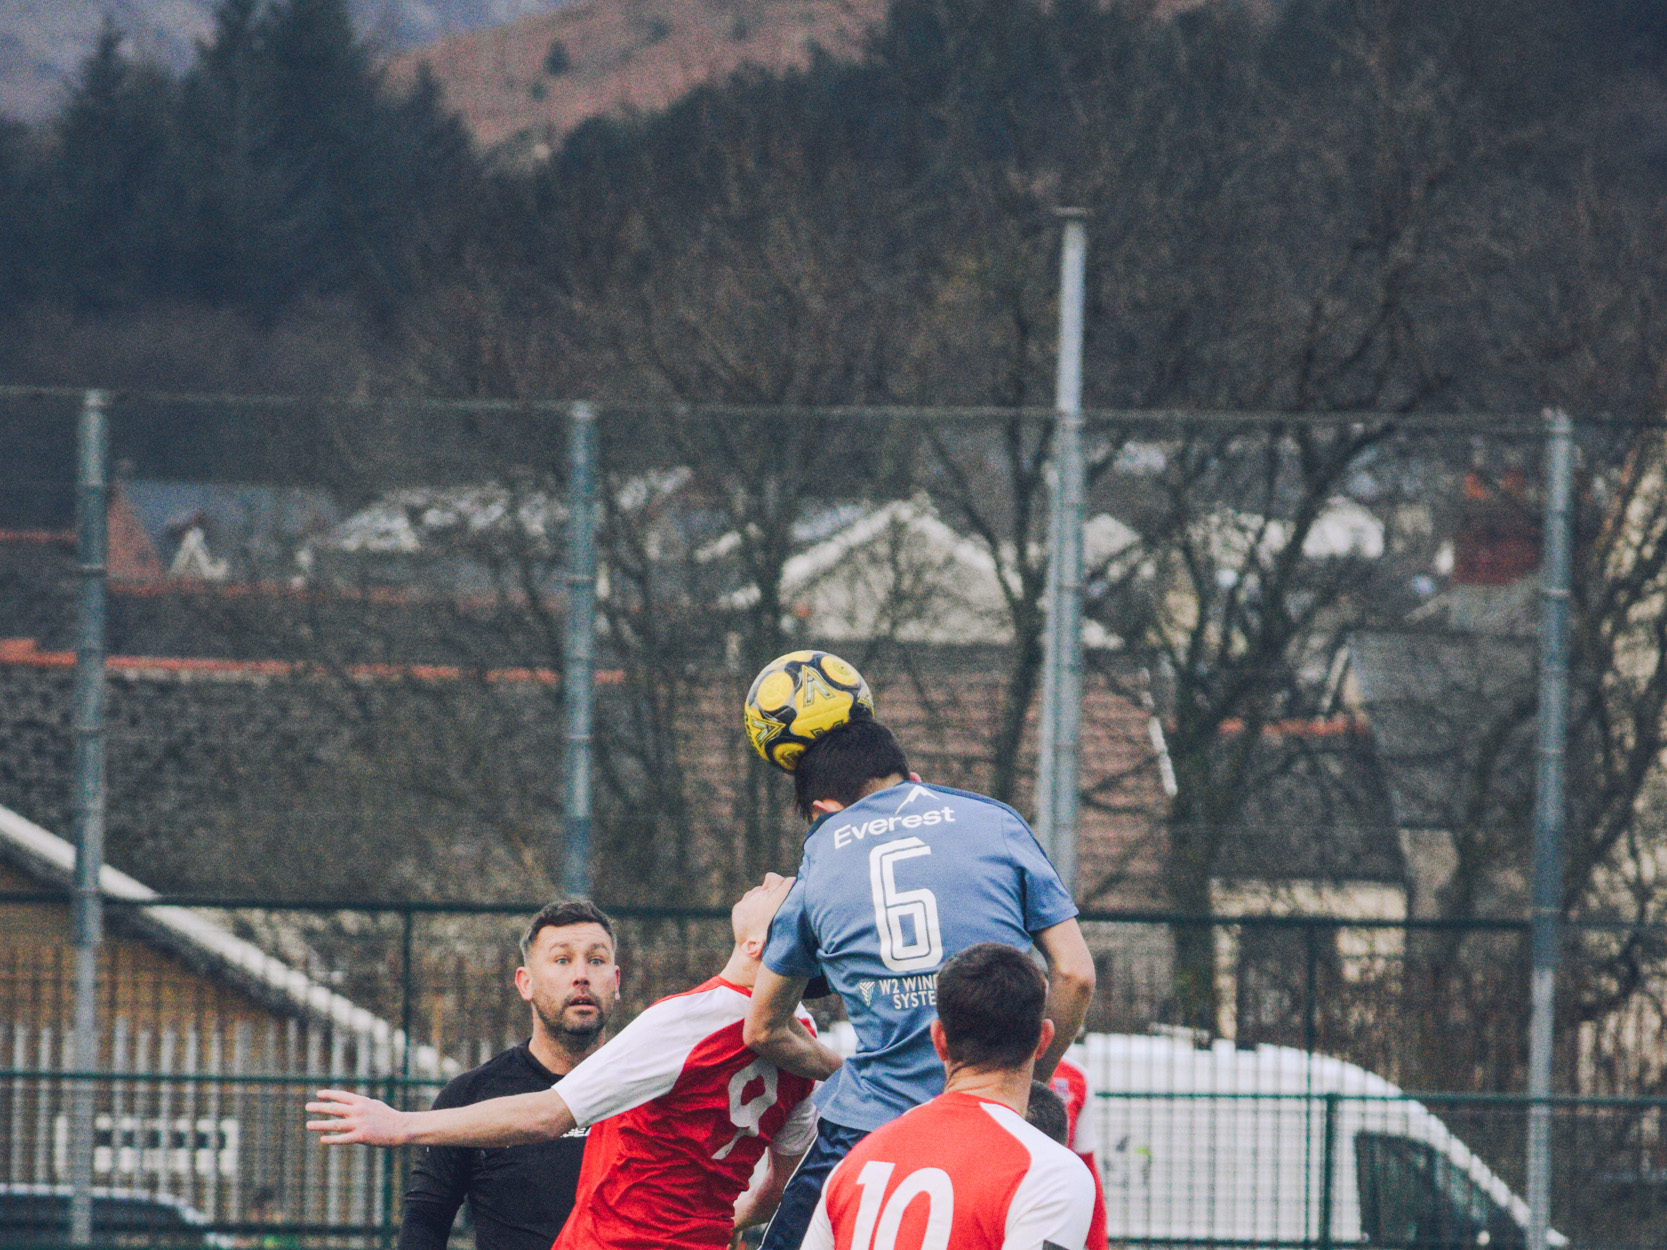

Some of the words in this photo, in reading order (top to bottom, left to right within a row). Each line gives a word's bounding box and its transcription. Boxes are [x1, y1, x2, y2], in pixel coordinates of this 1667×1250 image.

[833, 806, 956, 850] Everest
[869, 836, 944, 972] 6
[879, 978, 900, 995] W2
[893, 990, 938, 1010] SYSTE
[711, 1058, 778, 1160] 9
